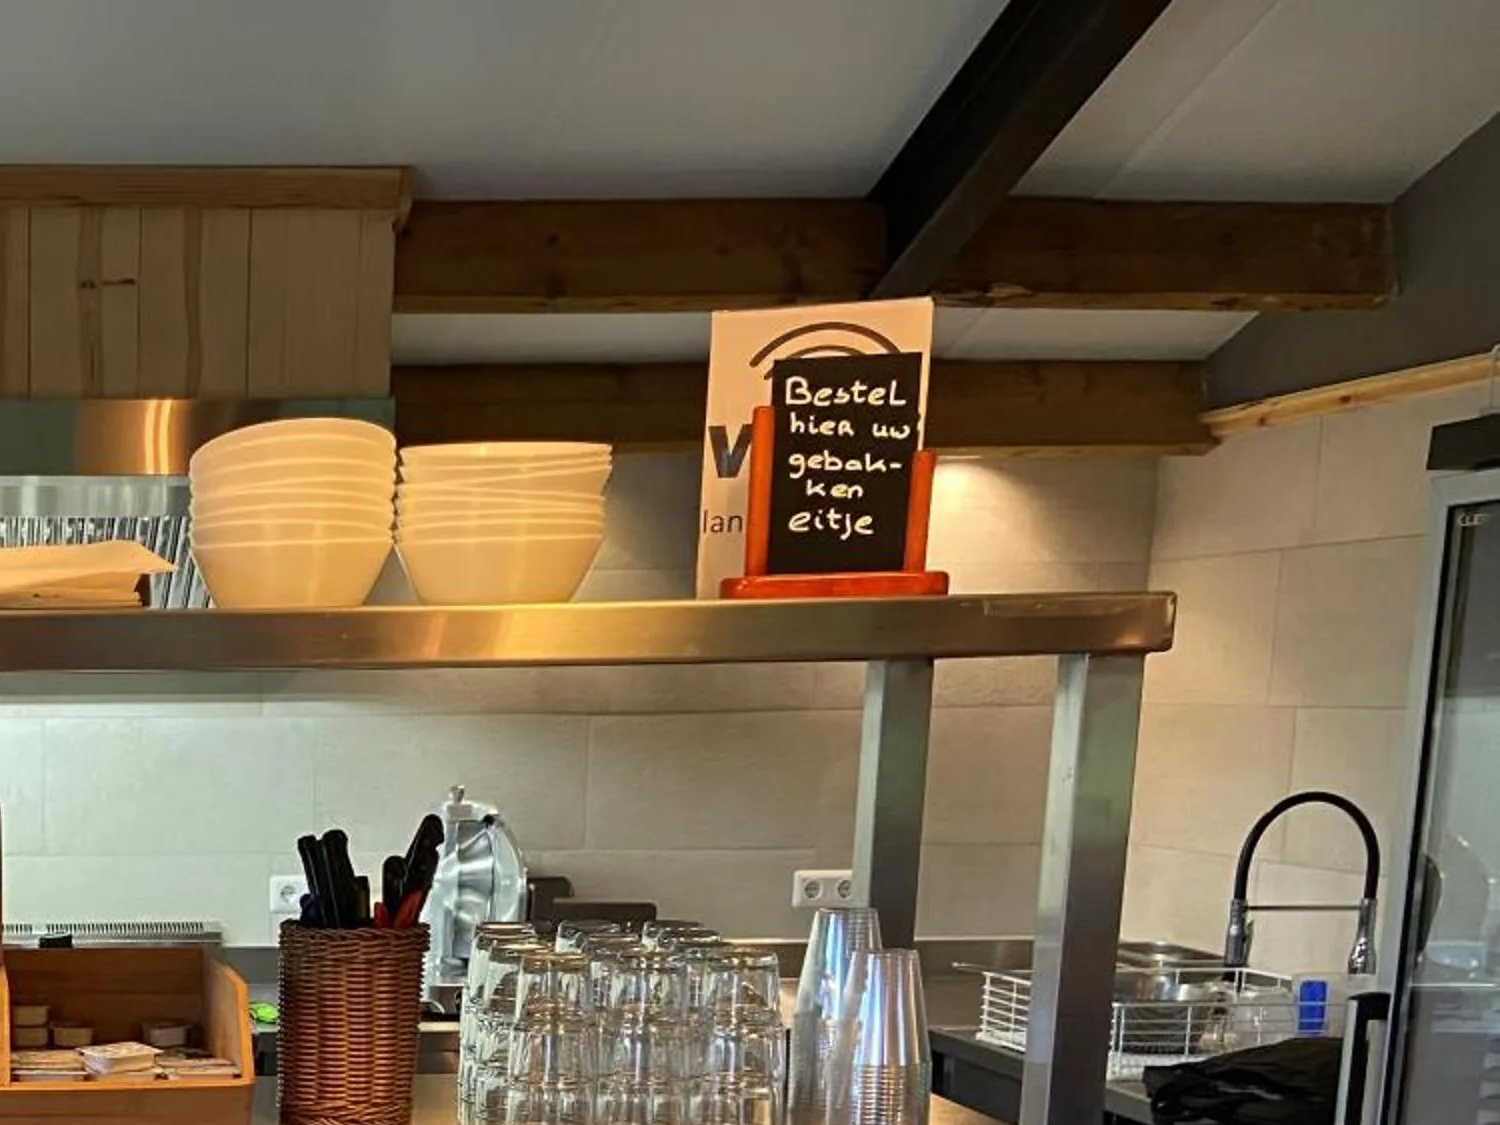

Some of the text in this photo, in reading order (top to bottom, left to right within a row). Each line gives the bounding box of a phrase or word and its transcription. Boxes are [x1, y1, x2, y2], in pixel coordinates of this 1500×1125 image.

[785, 376, 907, 406] Bestel
[790, 411, 911, 439] hier uw
[788, 449, 902, 479] gebak-
[805, 479, 863, 499] ken
[788, 508, 874, 540] eitje
